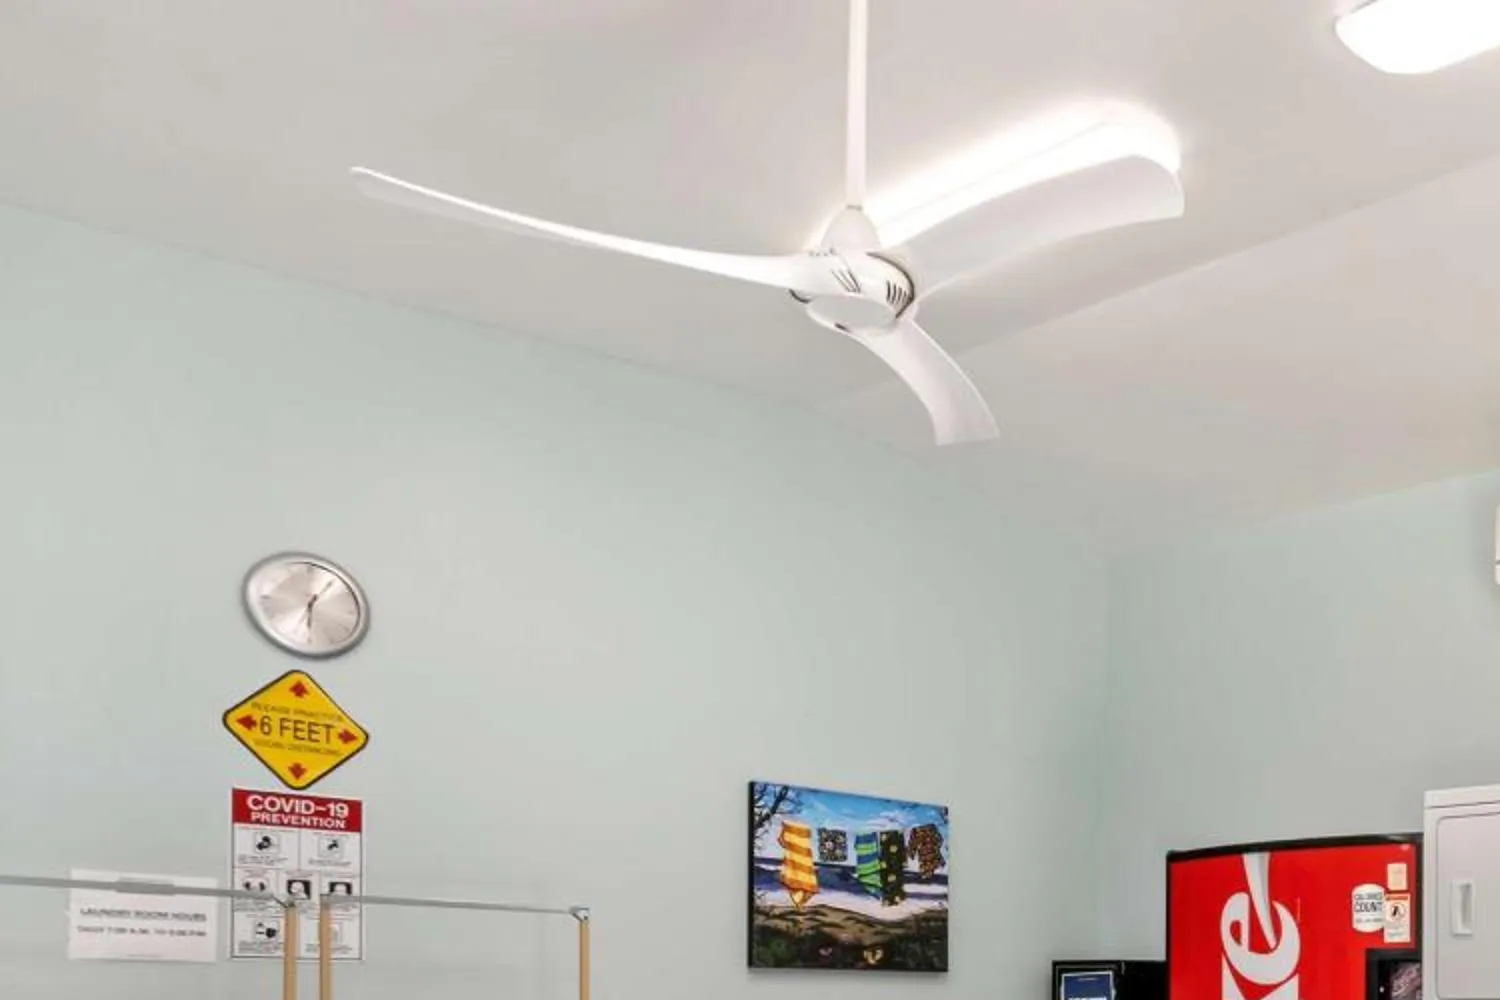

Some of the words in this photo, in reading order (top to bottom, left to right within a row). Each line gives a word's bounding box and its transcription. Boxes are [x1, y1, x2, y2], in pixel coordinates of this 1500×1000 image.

[259, 715, 272, 735] 6
[279, 717, 335, 744] FEET
[246, 794, 350, 819] COVID-19
[250, 811, 347, 830] PREVENTION
